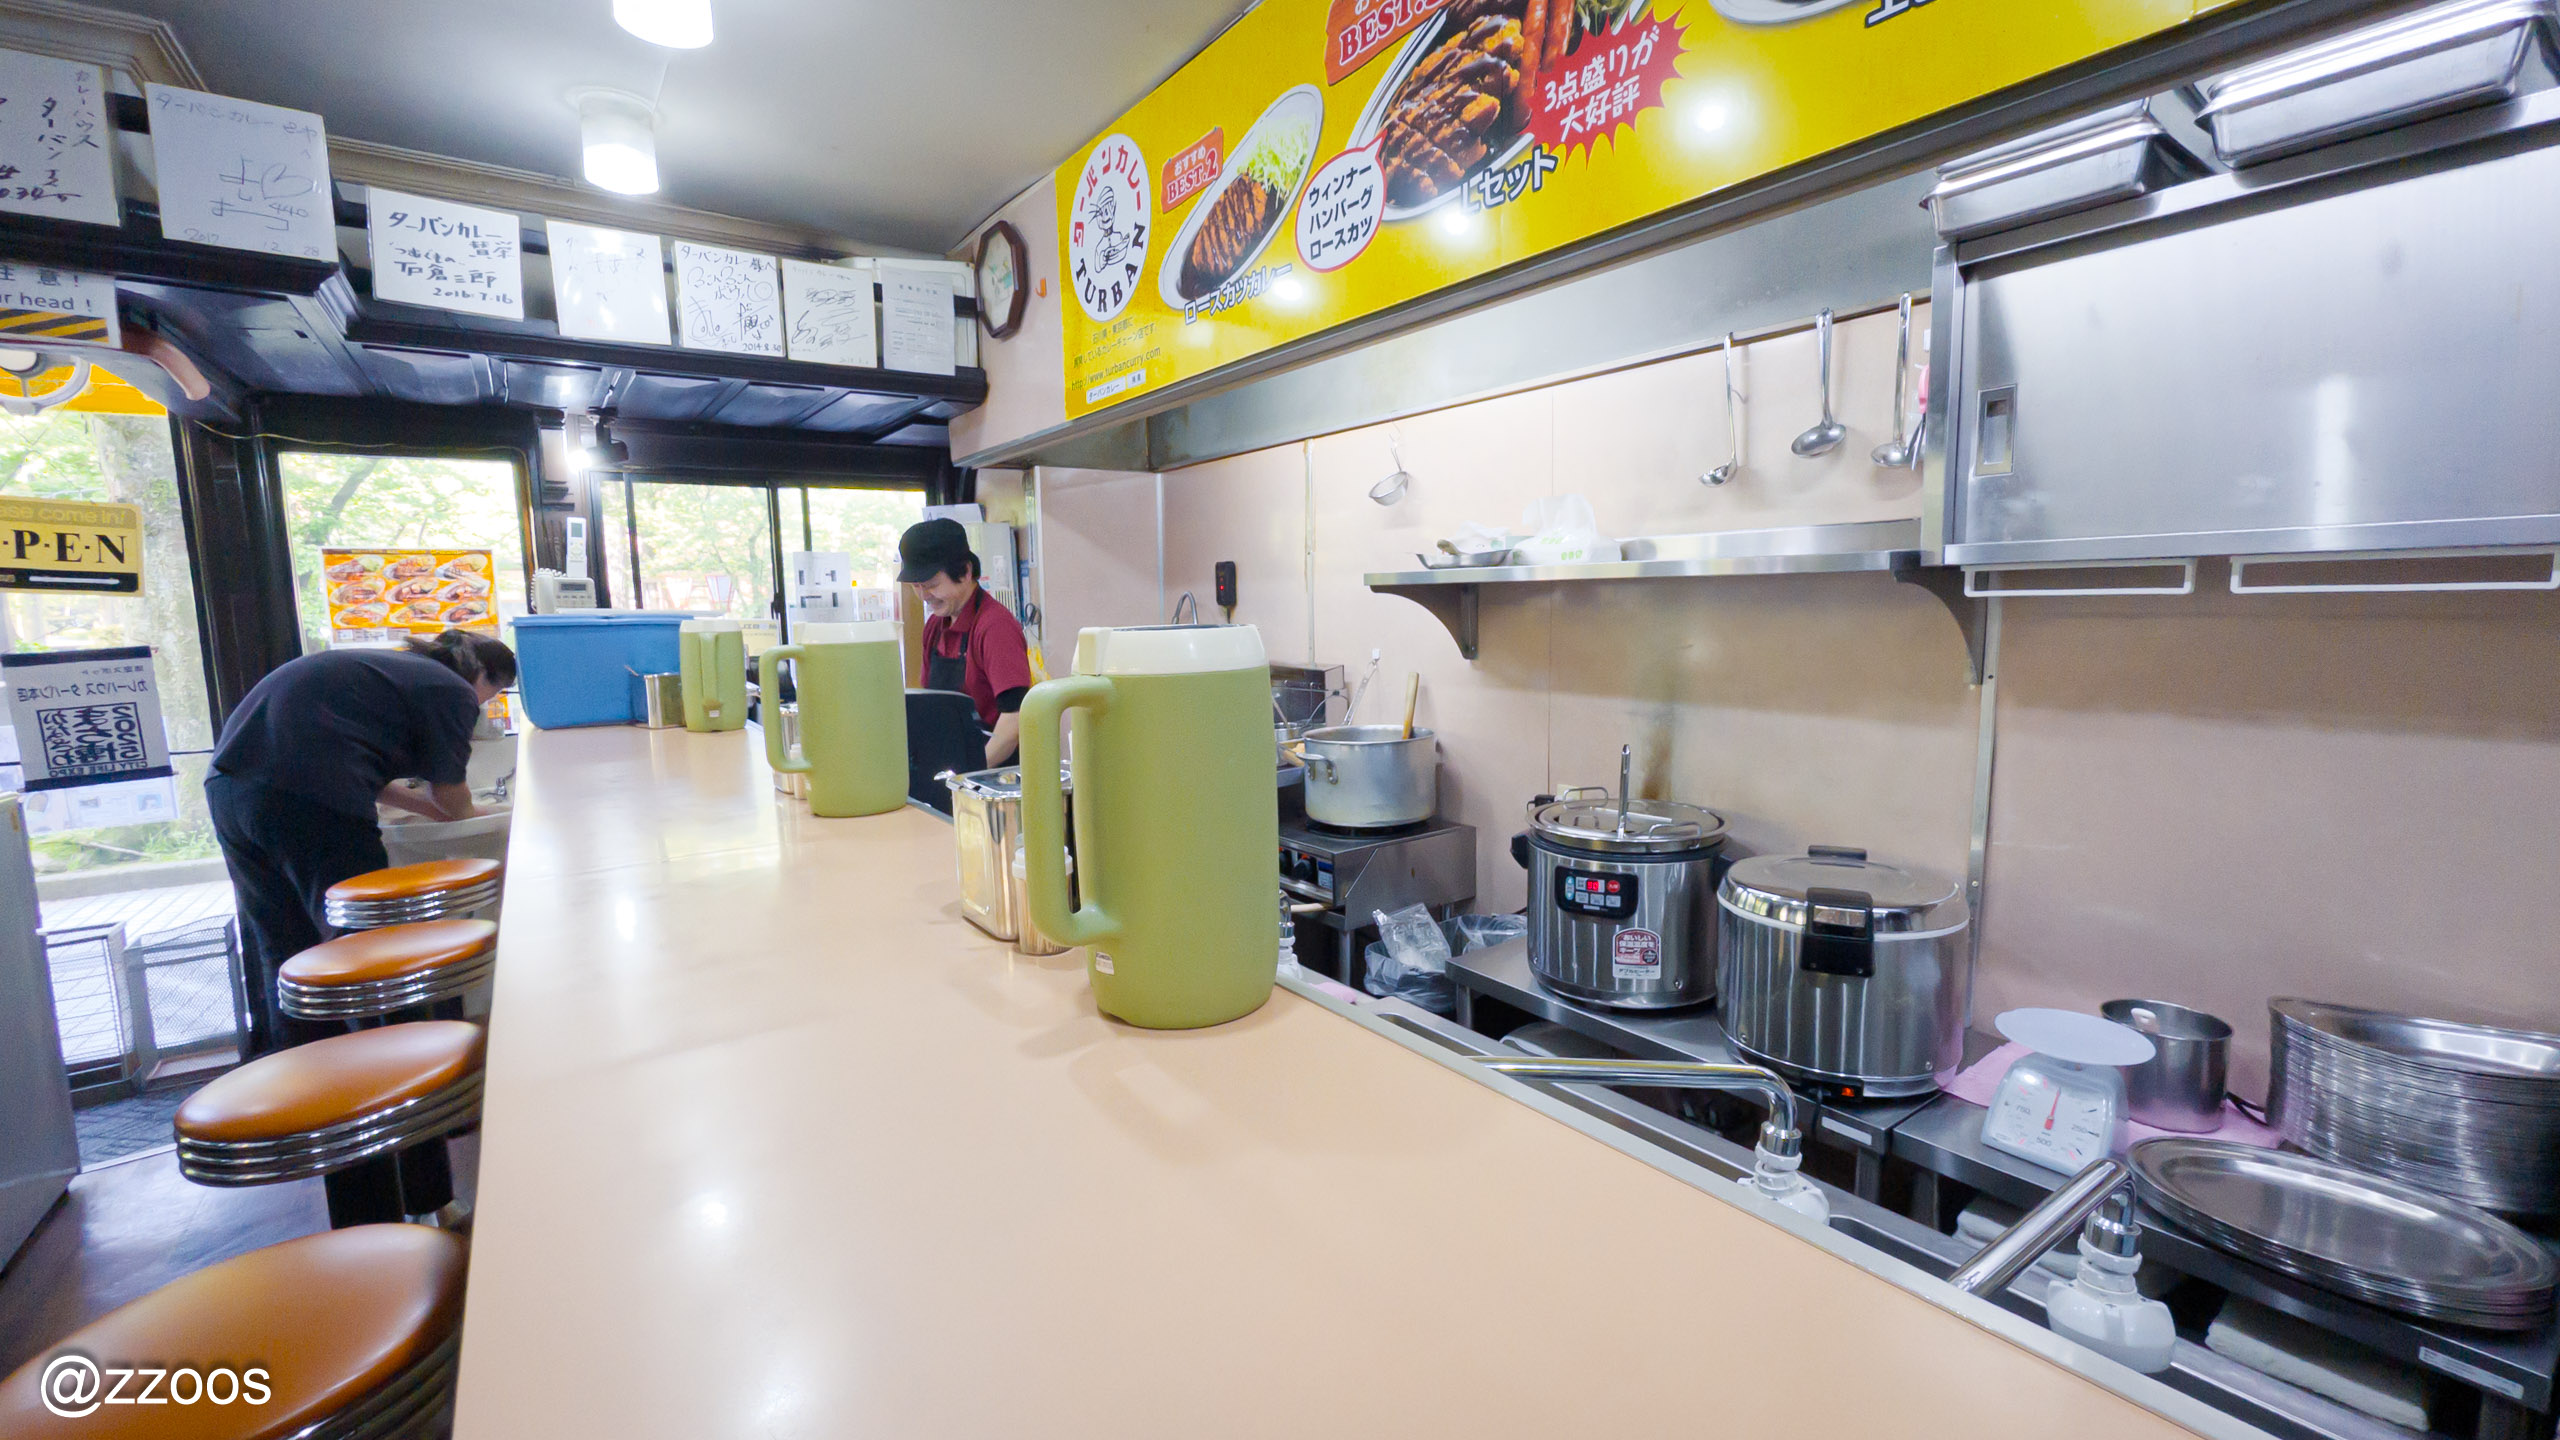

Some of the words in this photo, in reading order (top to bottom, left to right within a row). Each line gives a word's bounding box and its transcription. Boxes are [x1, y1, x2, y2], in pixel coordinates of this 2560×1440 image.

[1544, 25, 1660, 113] 3点盛りが
[1560, 75, 1640, 143] 大好評
[1166, 148, 1220, 205] BEST.2
[1174, 145, 1207, 176] おすすめ
[1308, 163, 1373, 208] ウィンナー
[1309, 184, 1374, 234] ハンバーグ
[1310, 215, 1373, 260] ロースカツ
[1075, 221, 1146, 313] TURBAN
[19, 291, 75, 311] head
[1184, 263, 1293, 325] ロースカツカレー
[40, 507, 97, 523] come
[2035, 1135, 2053, 1148] 500
